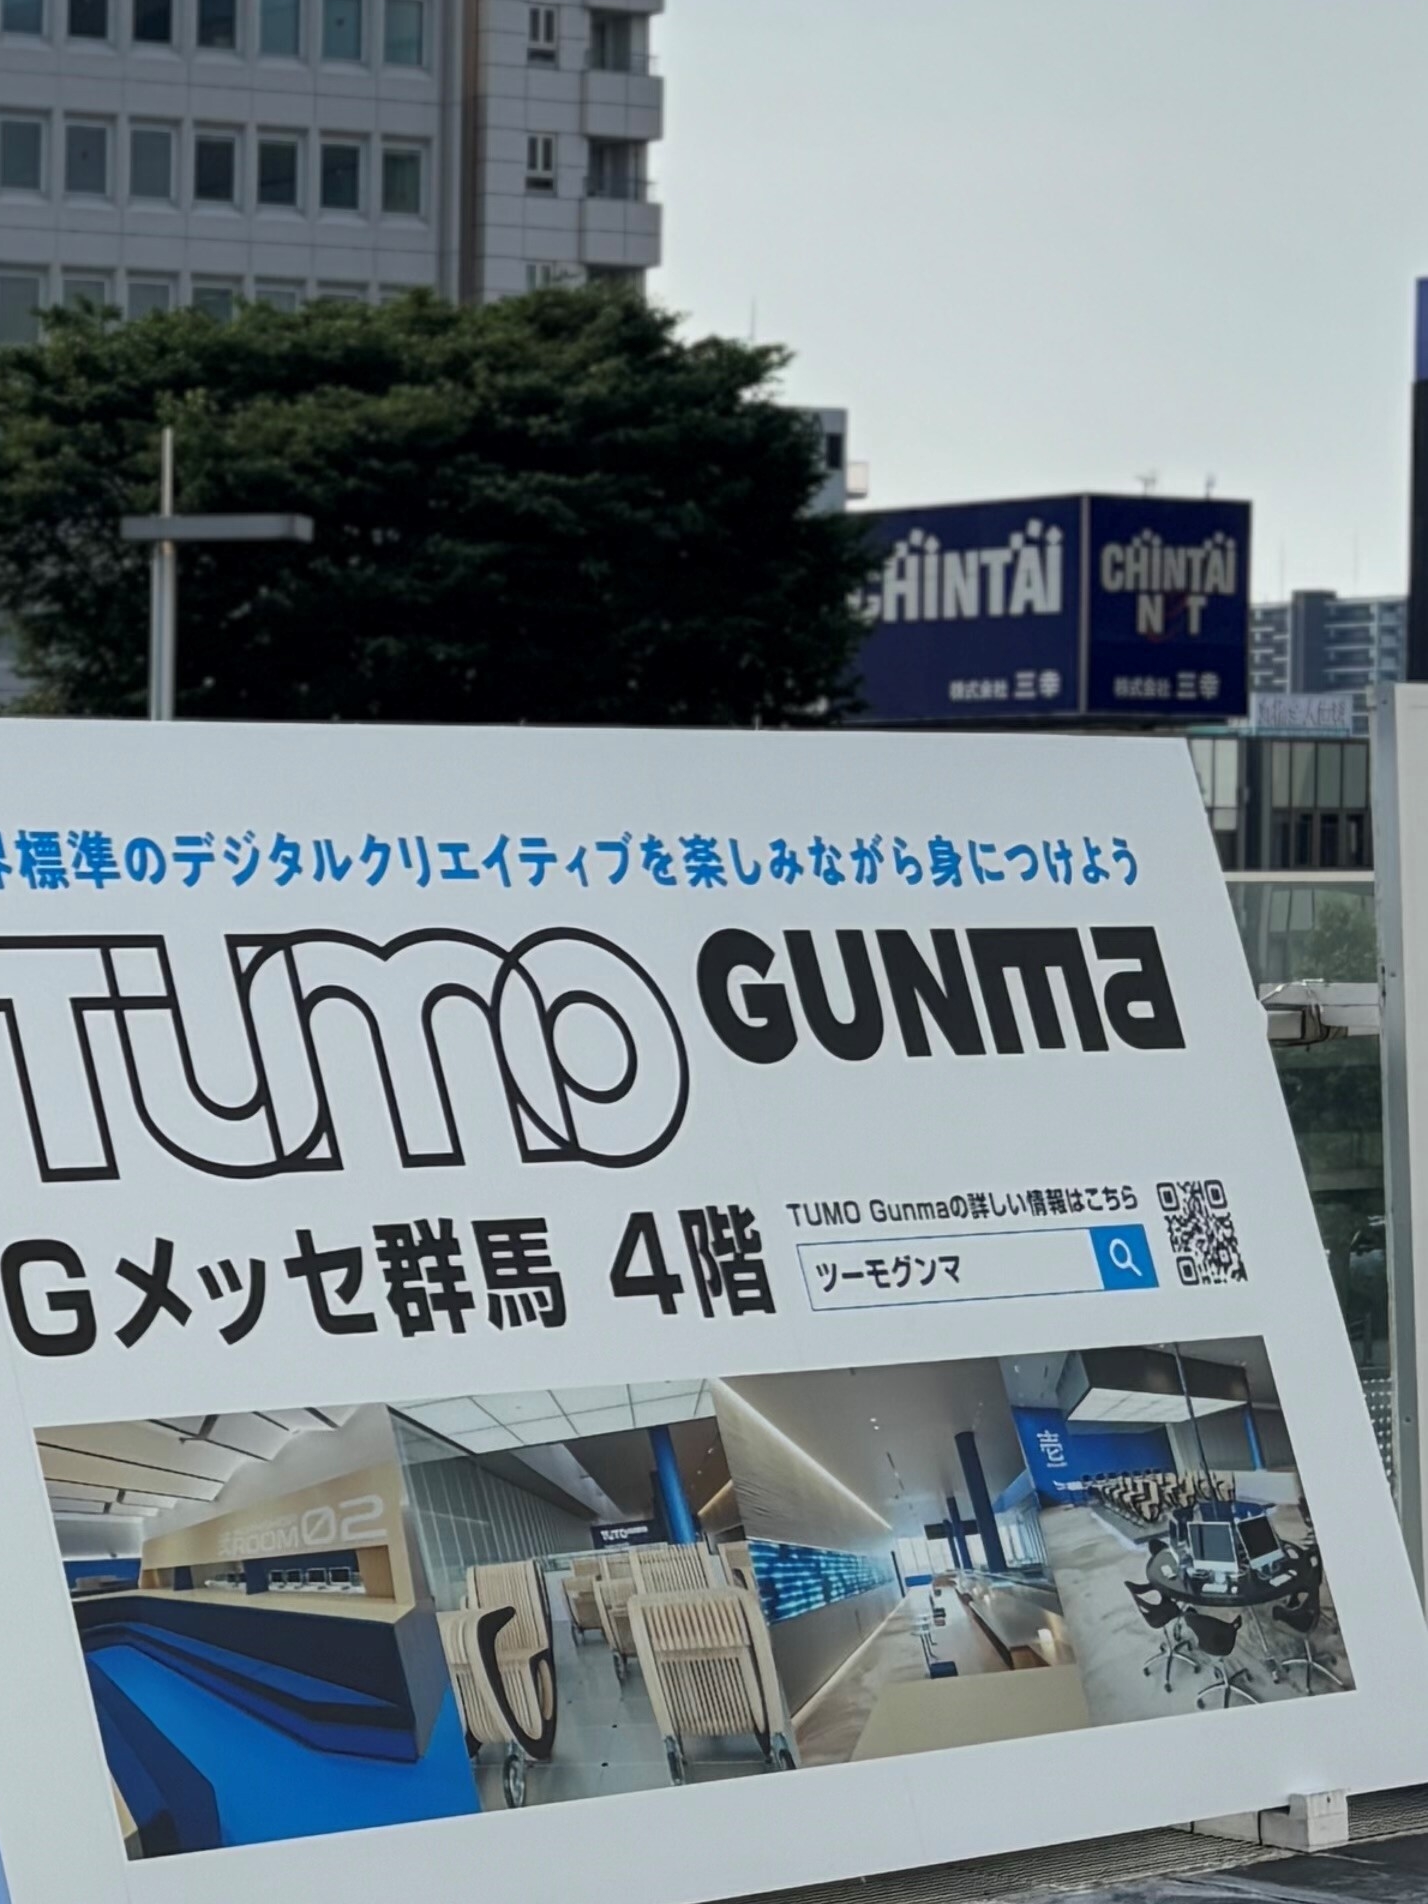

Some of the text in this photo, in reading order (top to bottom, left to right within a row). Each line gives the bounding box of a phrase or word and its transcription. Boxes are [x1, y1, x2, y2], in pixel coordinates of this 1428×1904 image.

[1101, 529, 1236, 595] CHINTAI
[786, 1185, 1138, 1227] TUMO Gunmaの詳しい情報はこちら
[0, 1204, 776, 1357] Gメッセ群馬 4階
[816, 1255, 961, 1293] ツーモグンマ
